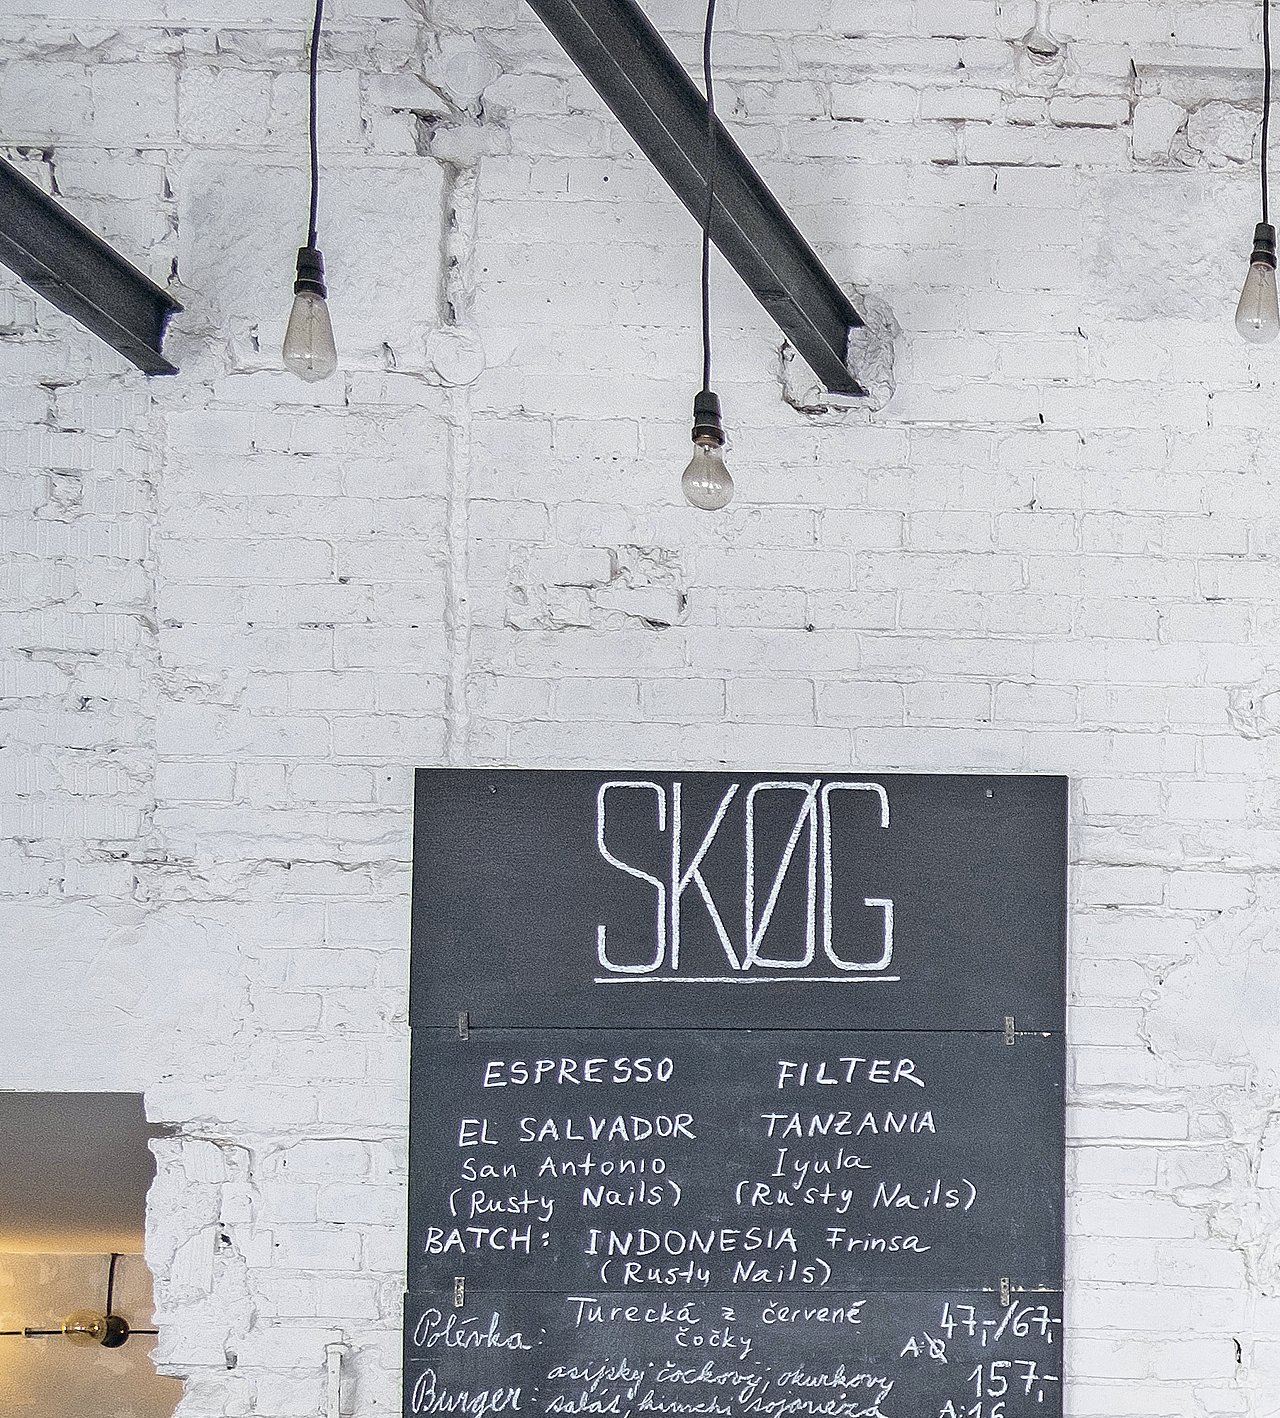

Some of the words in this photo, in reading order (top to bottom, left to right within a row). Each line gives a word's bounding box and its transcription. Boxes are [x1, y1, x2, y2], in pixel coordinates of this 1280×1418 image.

[597, 779, 894, 973] SKØG
[483, 1057, 674, 1088] ESPRESSO
[778, 1058, 924, 1088] FILTER
[458, 1119, 498, 1147] EL
[520, 1114, 696, 1142] SALVADOR
[761, 1111, 936, 1138] TANZANIA
[461, 1158, 517, 1181] San
[539, 1153, 666, 1177] Antonio
[771, 1148, 872, 1189] Iyula
[450, 1188, 555, 1222] (Rusty
[582, 1180, 682, 1207] Nails)
[736, 1181, 853, 1213] (Rusty
[873, 1179, 976, 1210] Nails)
[424, 1225, 550, 1254] BATCH:
[584, 1228, 797, 1255] INDONESIA
[827, 1228, 930, 1252] Frinsa
[601, 1260, 710, 1285] (Rusty
[733, 1258, 832, 1285] Nails)
[568, 1297, 700, 1327] Turecká
[721, 1306, 736, 1321] z
[762, 1300, 866, 1324] červené
